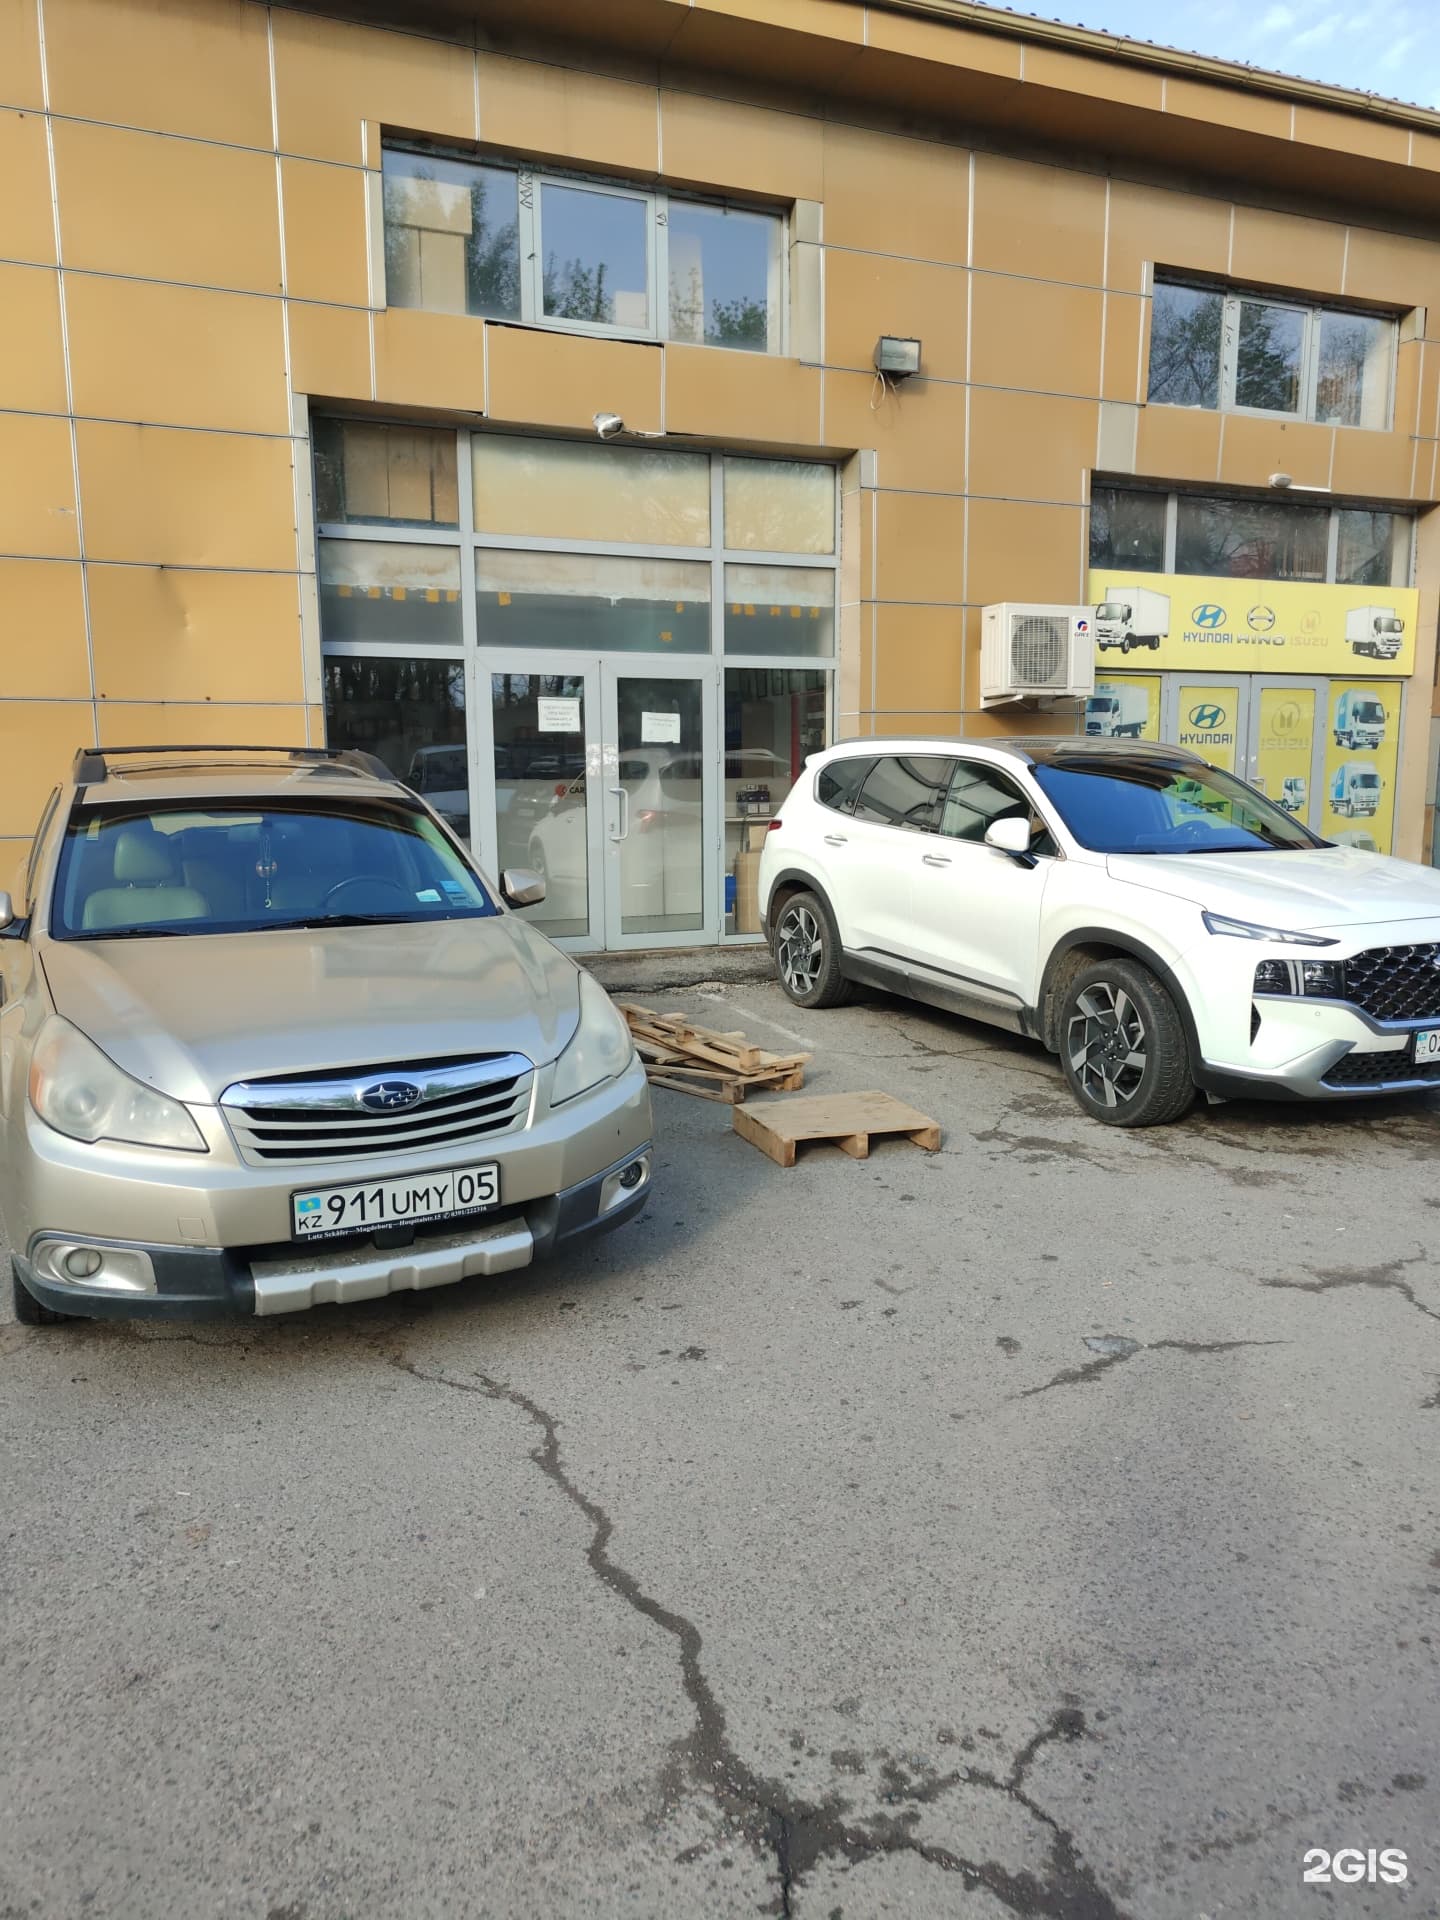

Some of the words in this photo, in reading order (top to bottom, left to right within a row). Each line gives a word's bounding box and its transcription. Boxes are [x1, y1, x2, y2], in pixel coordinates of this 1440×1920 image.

[1183, 632, 1233, 644] HYUNDAI
[1236, 634, 1286, 646] HINO
[1289, 636, 1329, 648] ISUZU
[1180, 733, 1233, 744] HYUNDAI
[457, 1171, 495, 1204] 05
[298, 1215, 323, 1230] KZ
